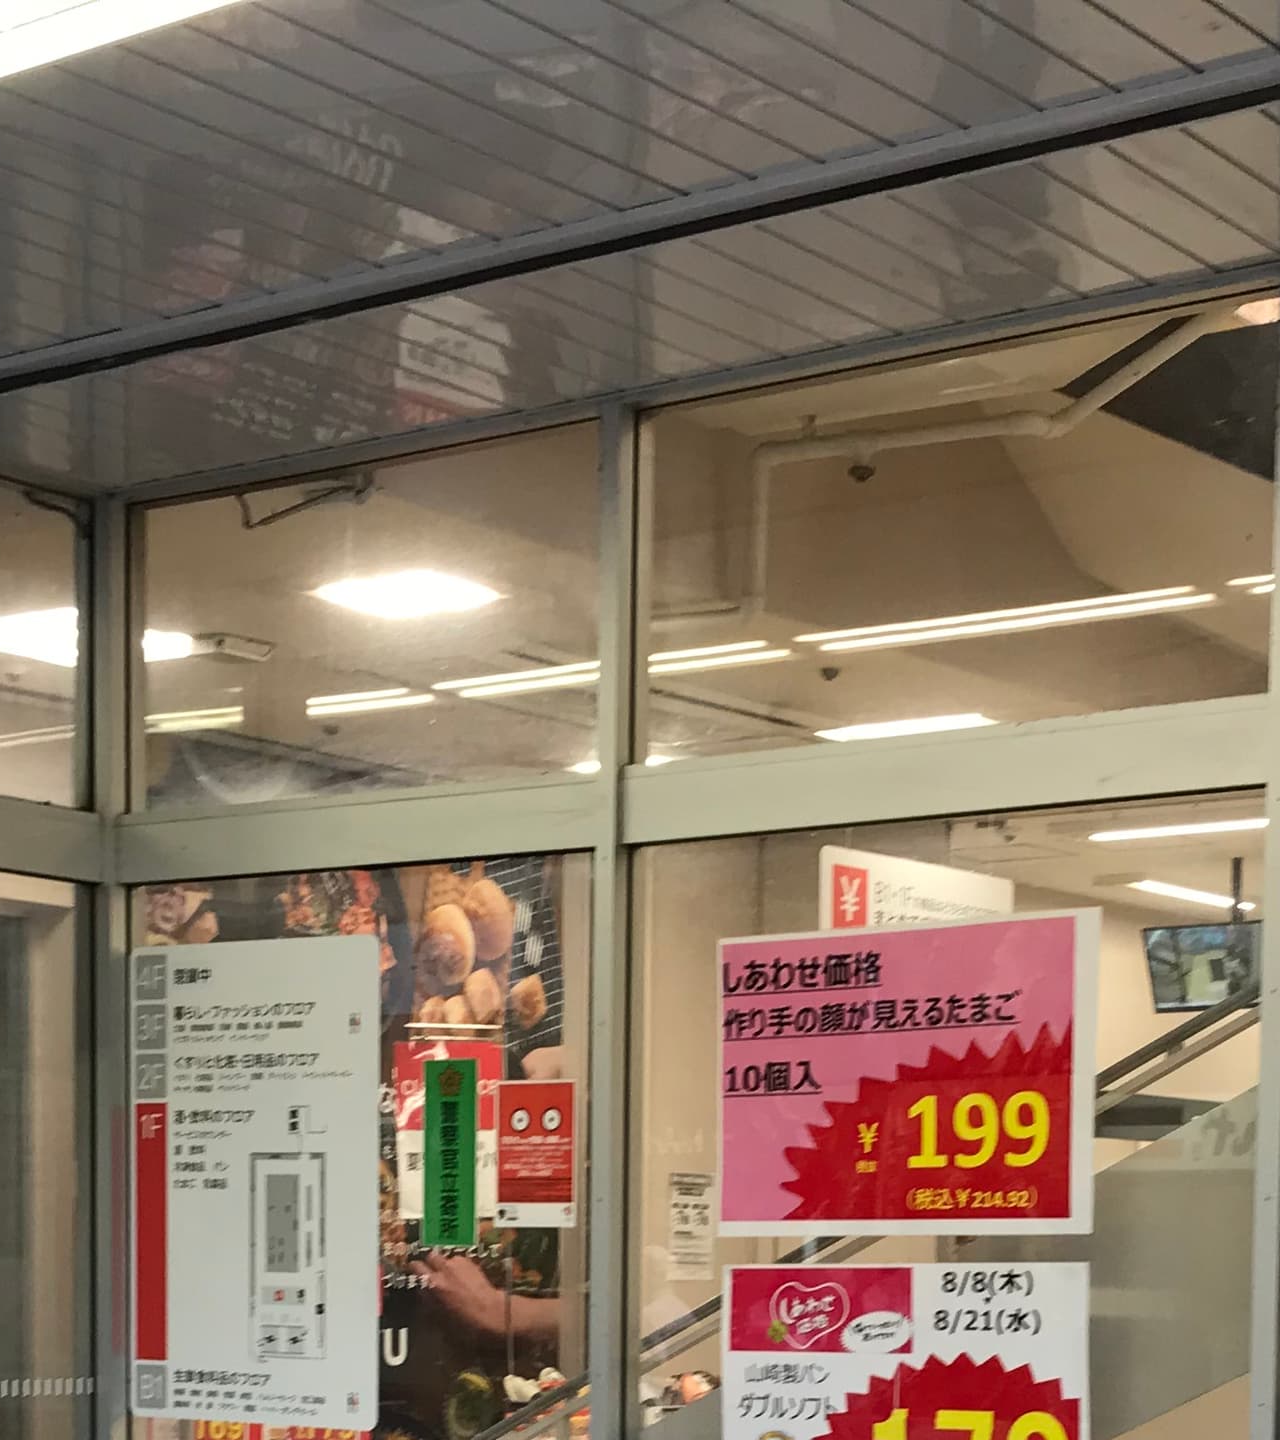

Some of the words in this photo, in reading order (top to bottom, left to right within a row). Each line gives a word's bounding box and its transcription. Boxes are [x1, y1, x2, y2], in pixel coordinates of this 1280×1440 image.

[723, 952, 882, 993] しあわせ価格
[723, 988, 1023, 1038] 作り手の顔が見えるたまご
[724, 1061, 822, 1094] 10個入
[907, 1090, 1050, 1168] 199
[942, 1269, 1035, 1298] 8/8(木)
[933, 1308, 1042, 1337] 8/21(水)
[743, 1363, 830, 1384] 山崎製パン
